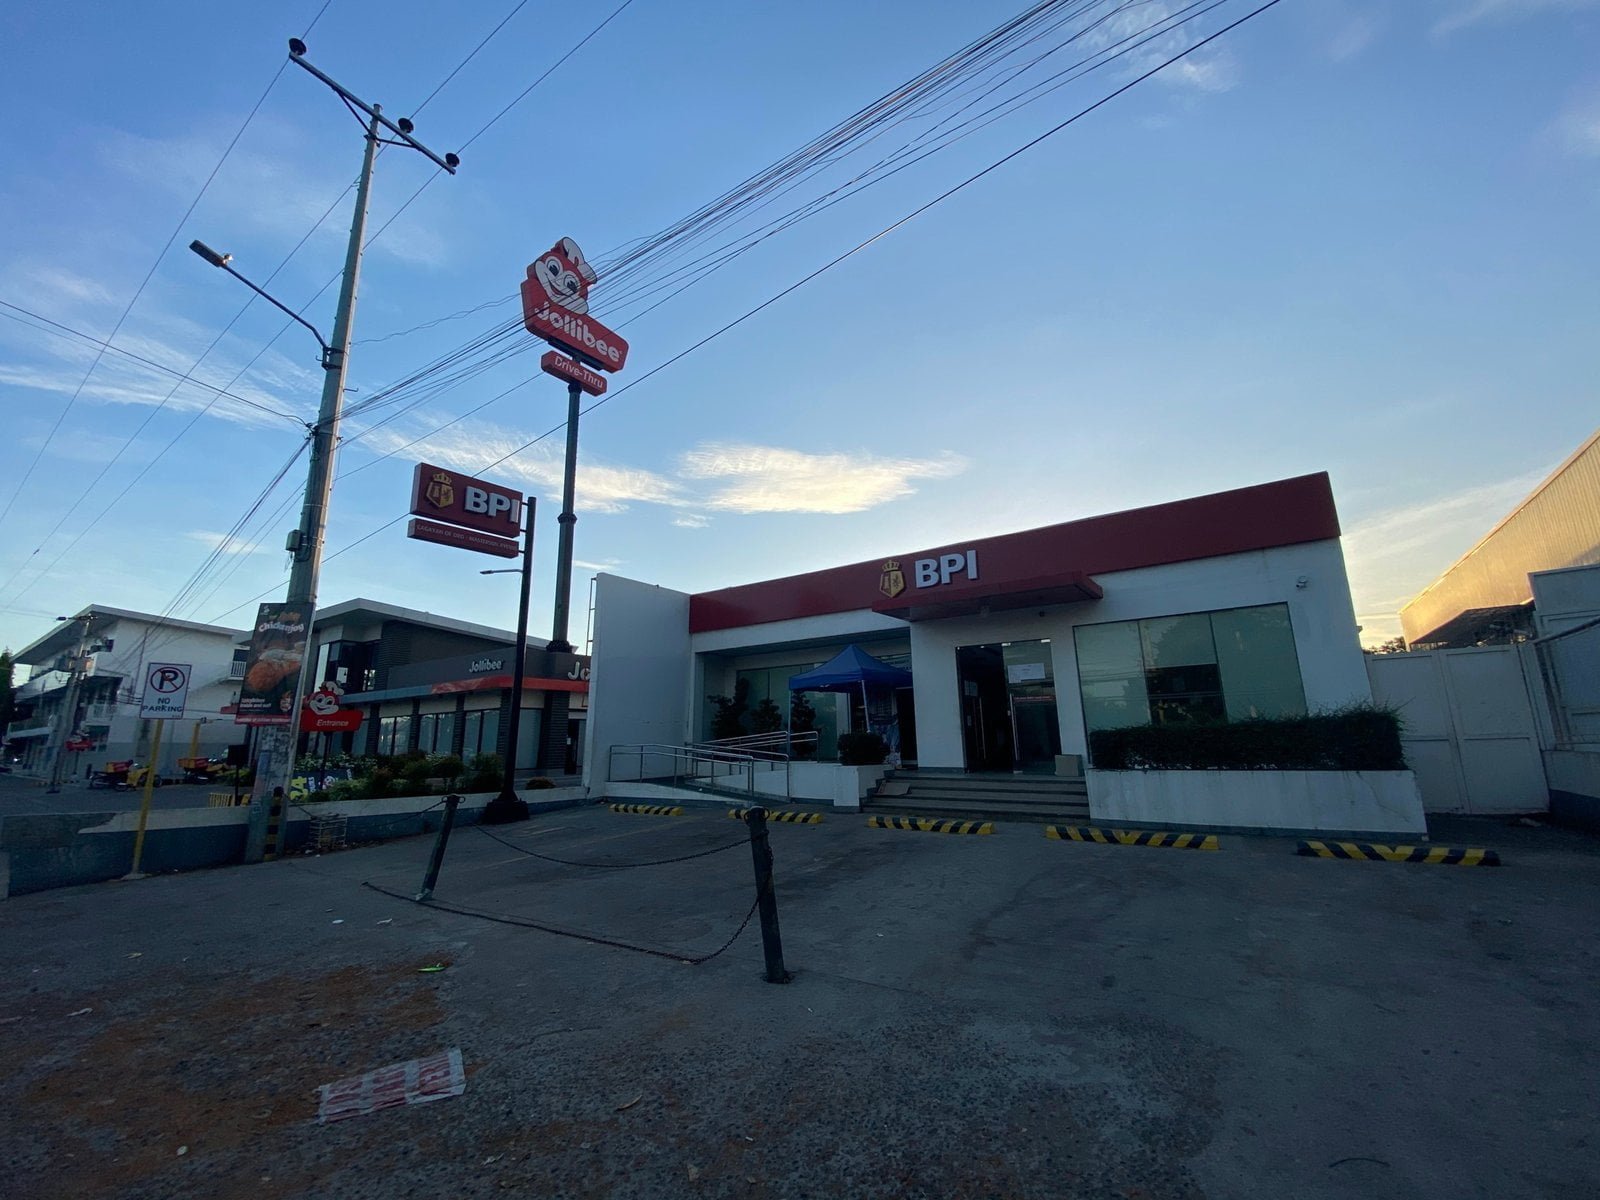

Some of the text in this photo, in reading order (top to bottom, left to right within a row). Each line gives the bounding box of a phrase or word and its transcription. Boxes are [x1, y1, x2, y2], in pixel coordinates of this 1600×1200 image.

[534, 301, 620, 362] Jollibee
[555, 356, 603, 388] Drive-Thru
[464, 485, 520, 523] BPI
[915, 549, 978, 589] BPI
[469, 658, 502, 672] Jollibee
[142, 704, 184, 712] PARKING
[316, 719, 349, 727] Entrance
